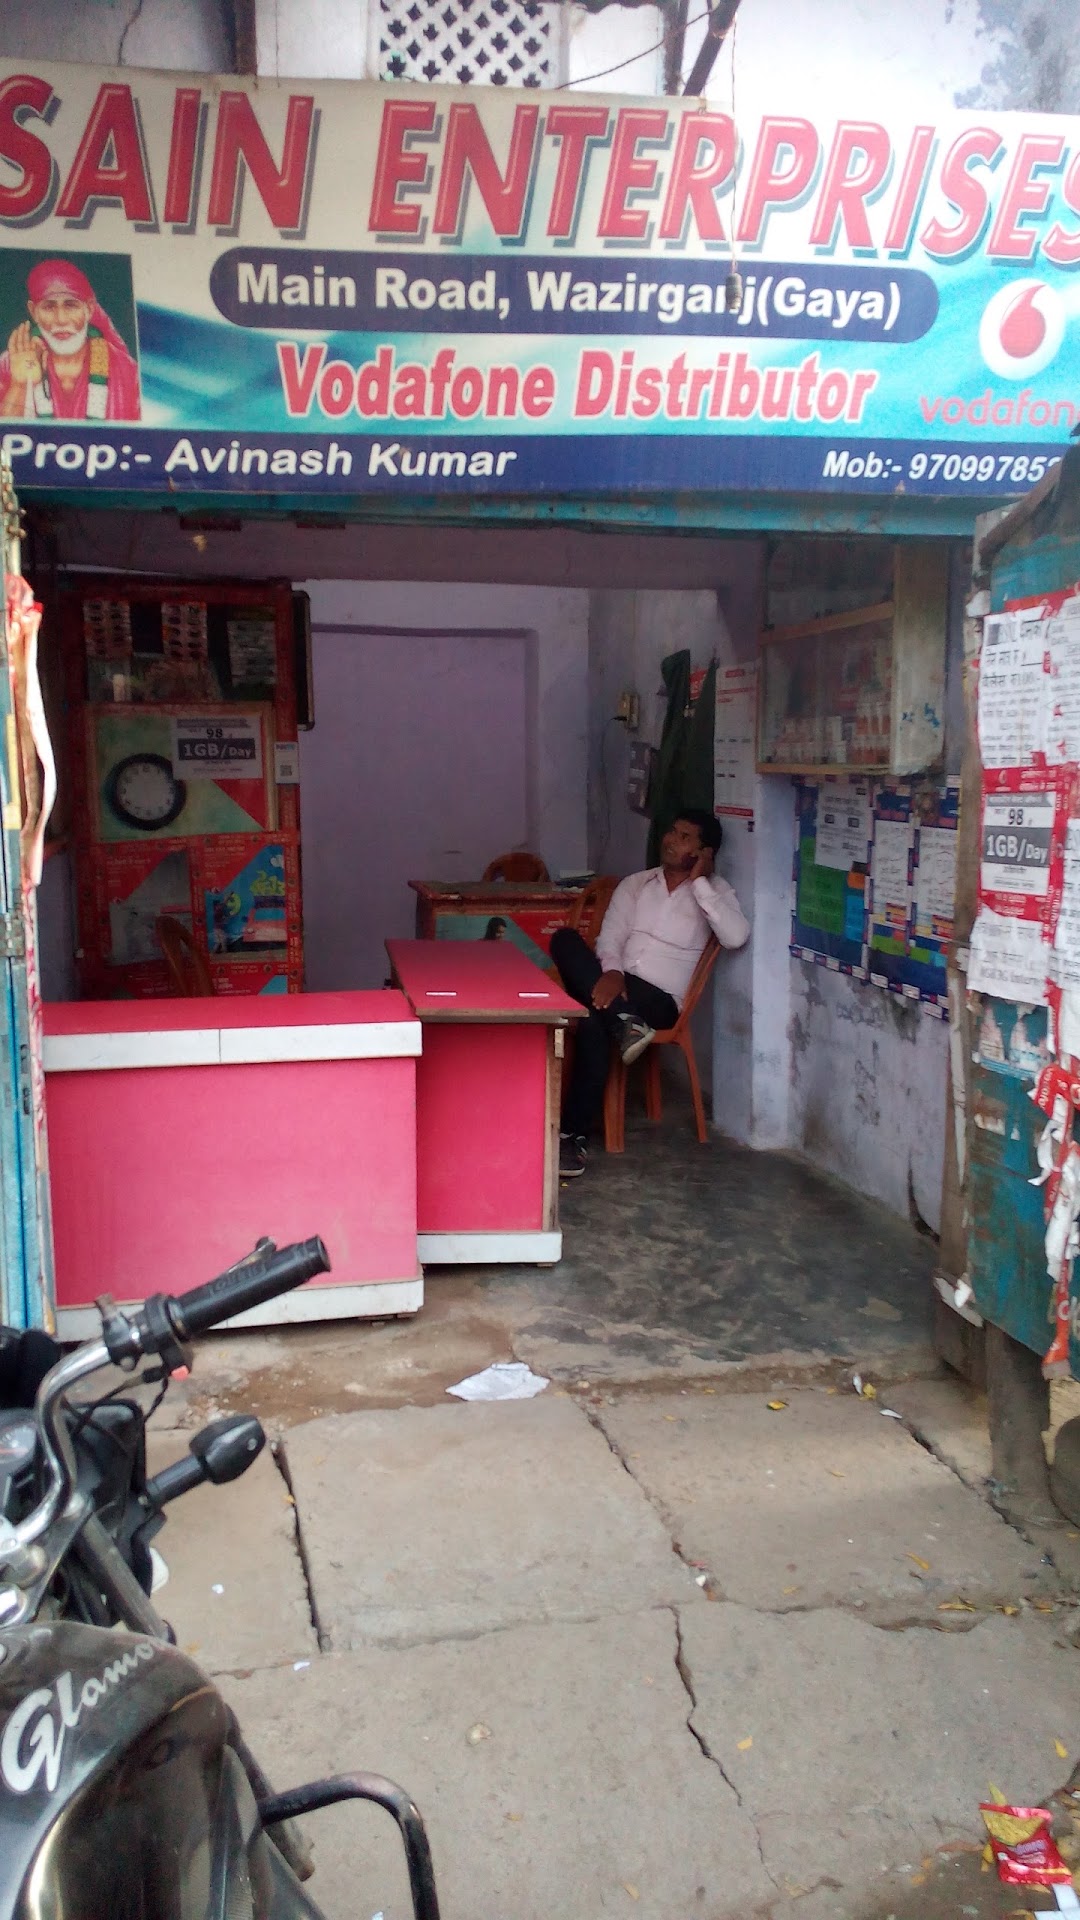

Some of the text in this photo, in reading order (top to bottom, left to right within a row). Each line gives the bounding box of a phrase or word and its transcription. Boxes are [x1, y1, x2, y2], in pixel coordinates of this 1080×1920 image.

[0, 74, 318, 239] SAIN
[237, 262, 356, 308] Main
[375, 267, 511, 320] Road,
[277, 341, 879, 424] Vodafone Distributor
[919, 387, 1080, 427] vodafon
[1, 433, 517, 479] Prop:- Avinash Kumar
[822, 449, 902, 480] Mob:-
[183, 742, 252, 759] 1GB/Day
[206, 728, 224, 738] 98
[1007, 807, 1024, 826] 98
[986, 834, 1048, 864] 1GB/Day
